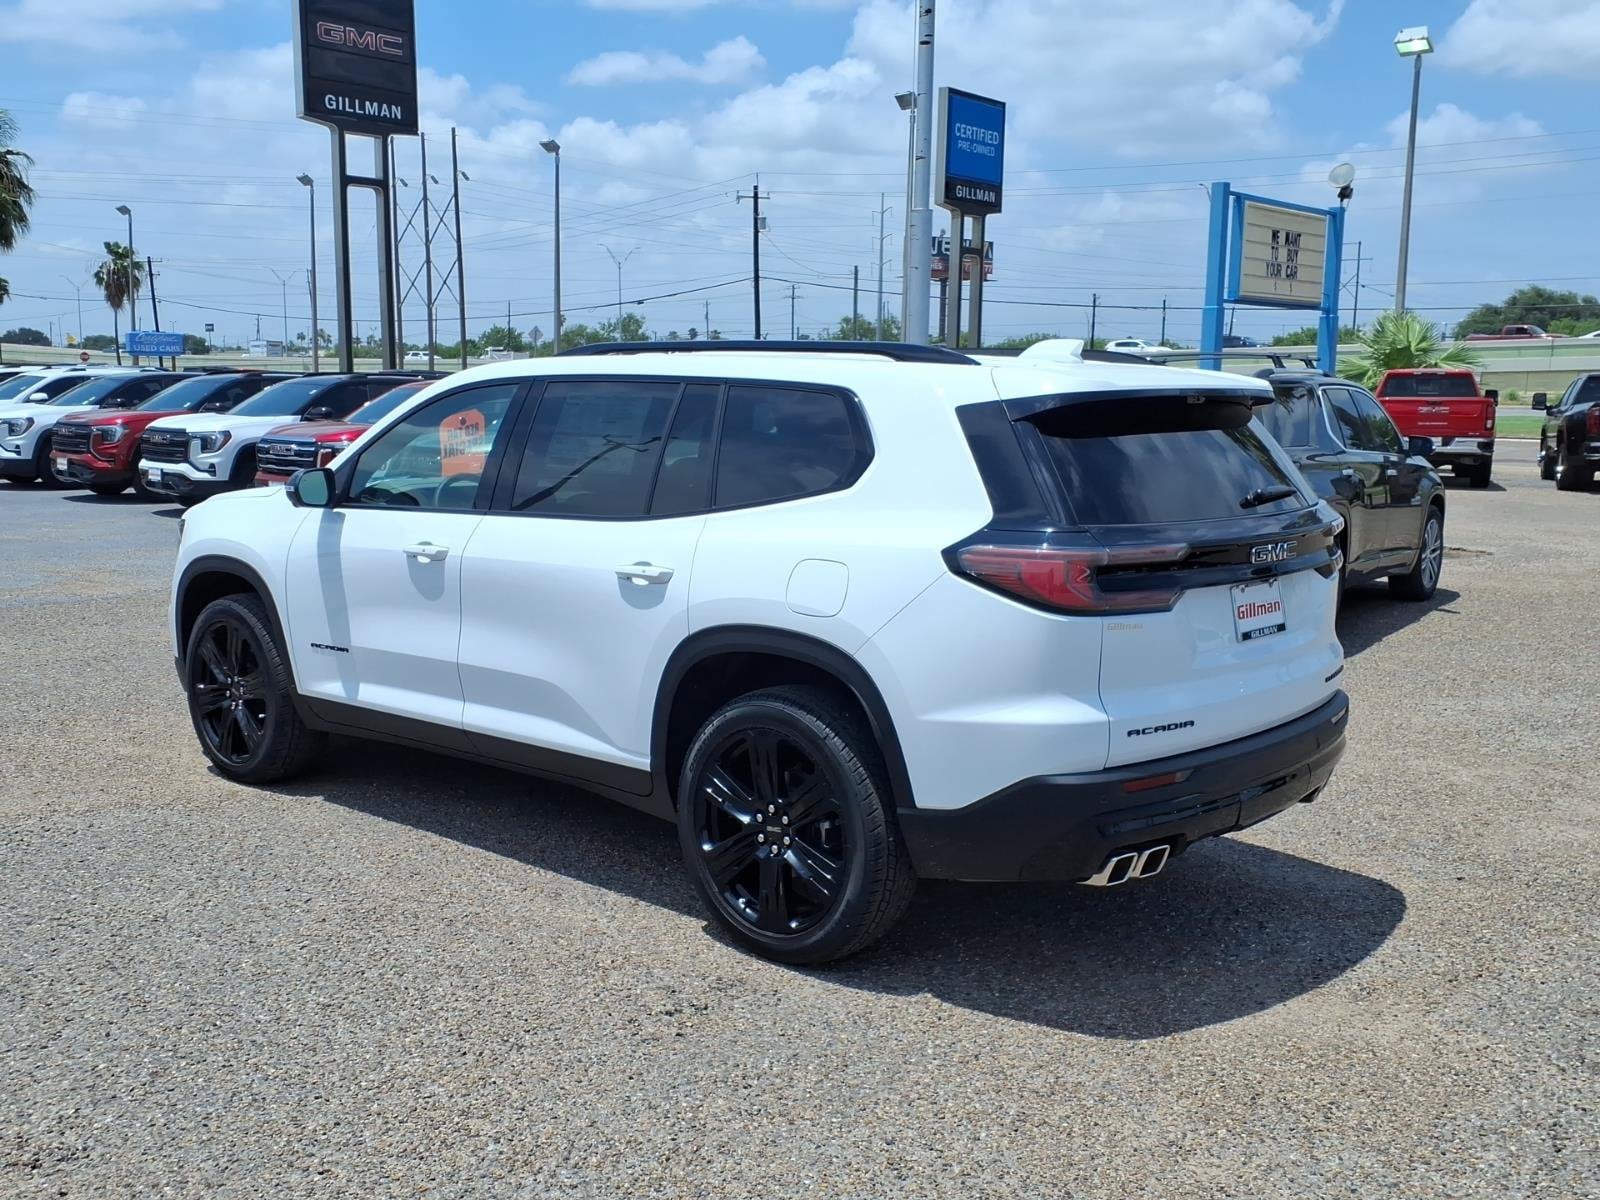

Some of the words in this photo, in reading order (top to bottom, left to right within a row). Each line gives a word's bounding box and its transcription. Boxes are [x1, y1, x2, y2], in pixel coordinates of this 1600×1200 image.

[317, 21, 403, 56] GMC
[324, 94, 401, 120] GILLMAN
[955, 122, 1000, 145] CERTIFIED
[957, 139, 995, 157] PRE-OWNED
[955, 185, 996, 203] GILLMAN
[1271, 229, 1280, 245] WE
[1285, 231, 1302, 249] WANT
[1271, 246, 1279, 261] TO
[1287, 248, 1299, 264] BUY
[1265, 261, 1282, 278] YOUR
[1285, 264, 1298, 280] CAR
[133, 344, 157, 352] USED
[159, 344, 182, 353] CARS
[1251, 540, 1297, 564] GMC
[1237, 600, 1281, 620] Gillman
[1250, 625, 1279, 639] GILLMAN
[310, 642, 349, 653] ACADIA
[1127, 720, 1195, 738] ACADIA
